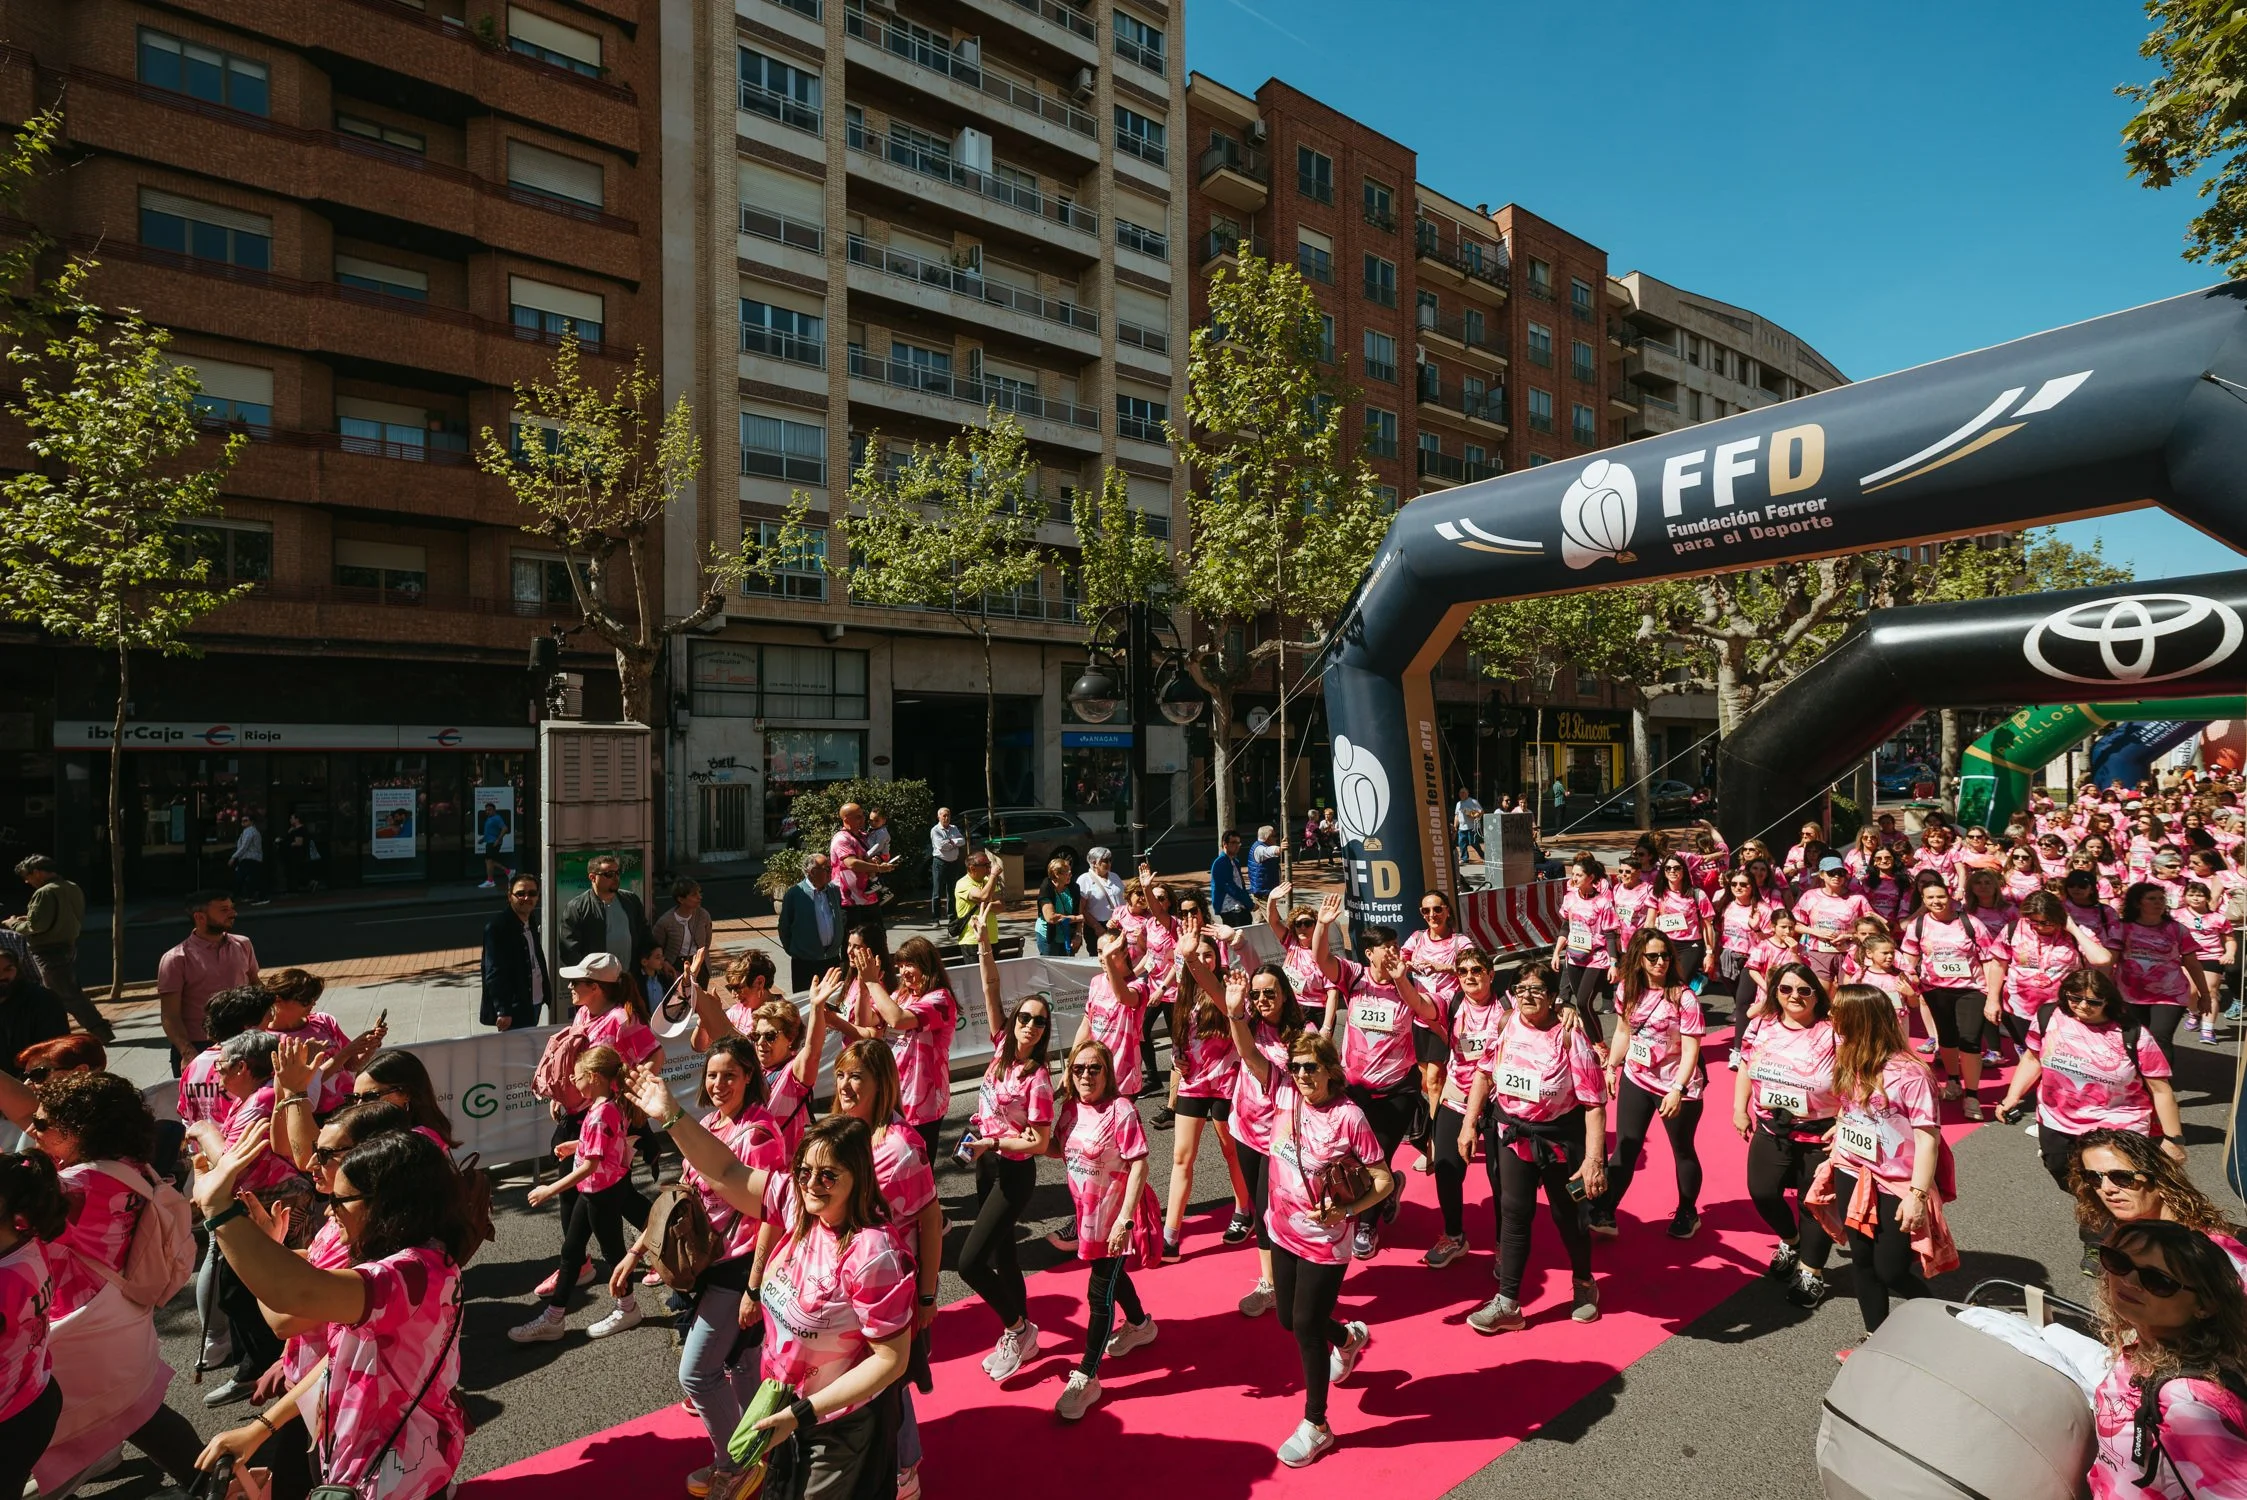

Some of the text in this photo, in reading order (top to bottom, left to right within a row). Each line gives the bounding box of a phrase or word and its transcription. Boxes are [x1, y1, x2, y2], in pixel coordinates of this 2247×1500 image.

[1662, 423, 1825, 518] FFD
[1666, 497, 1828, 538] Fundación Ferrer
[1672, 516, 1834, 555] para el Deporte
[1557, 711, 1571, 739] El
[244, 730, 282, 743] Rioja
[1371, 901, 1403, 912] Ferrer
[1364, 912, 1404, 924] Deporte
[1665, 919, 1680, 927] 254
[1573, 935, 1585, 944] 333
[1941, 963, 1961, 972] 963
[1361, 1009, 1386, 1022] 2313
[2051, 1056, 2066, 1064] por
[2055, 1048, 2090, 1063] Carrera
[1757, 1066, 1781, 1077] por la
[1760, 1058, 1792, 1070] Carrera
[671, 1073, 692, 1081] Rioja
[2050, 1062, 2116, 1086] Investigación
[1505, 1074, 1531, 1091] 2311
[1756, 1073, 1815, 1092] Investigación
[506, 1103, 518, 1111] en
[520, 1101, 533, 1109] La
[1768, 1092, 1800, 1108] 7836
[1841, 1126, 1872, 1150] 11208
[764, 1282, 787, 1307] por la
[762, 1293, 818, 1339] Investigación
[2134, 1427, 2142, 1457] Quechua
